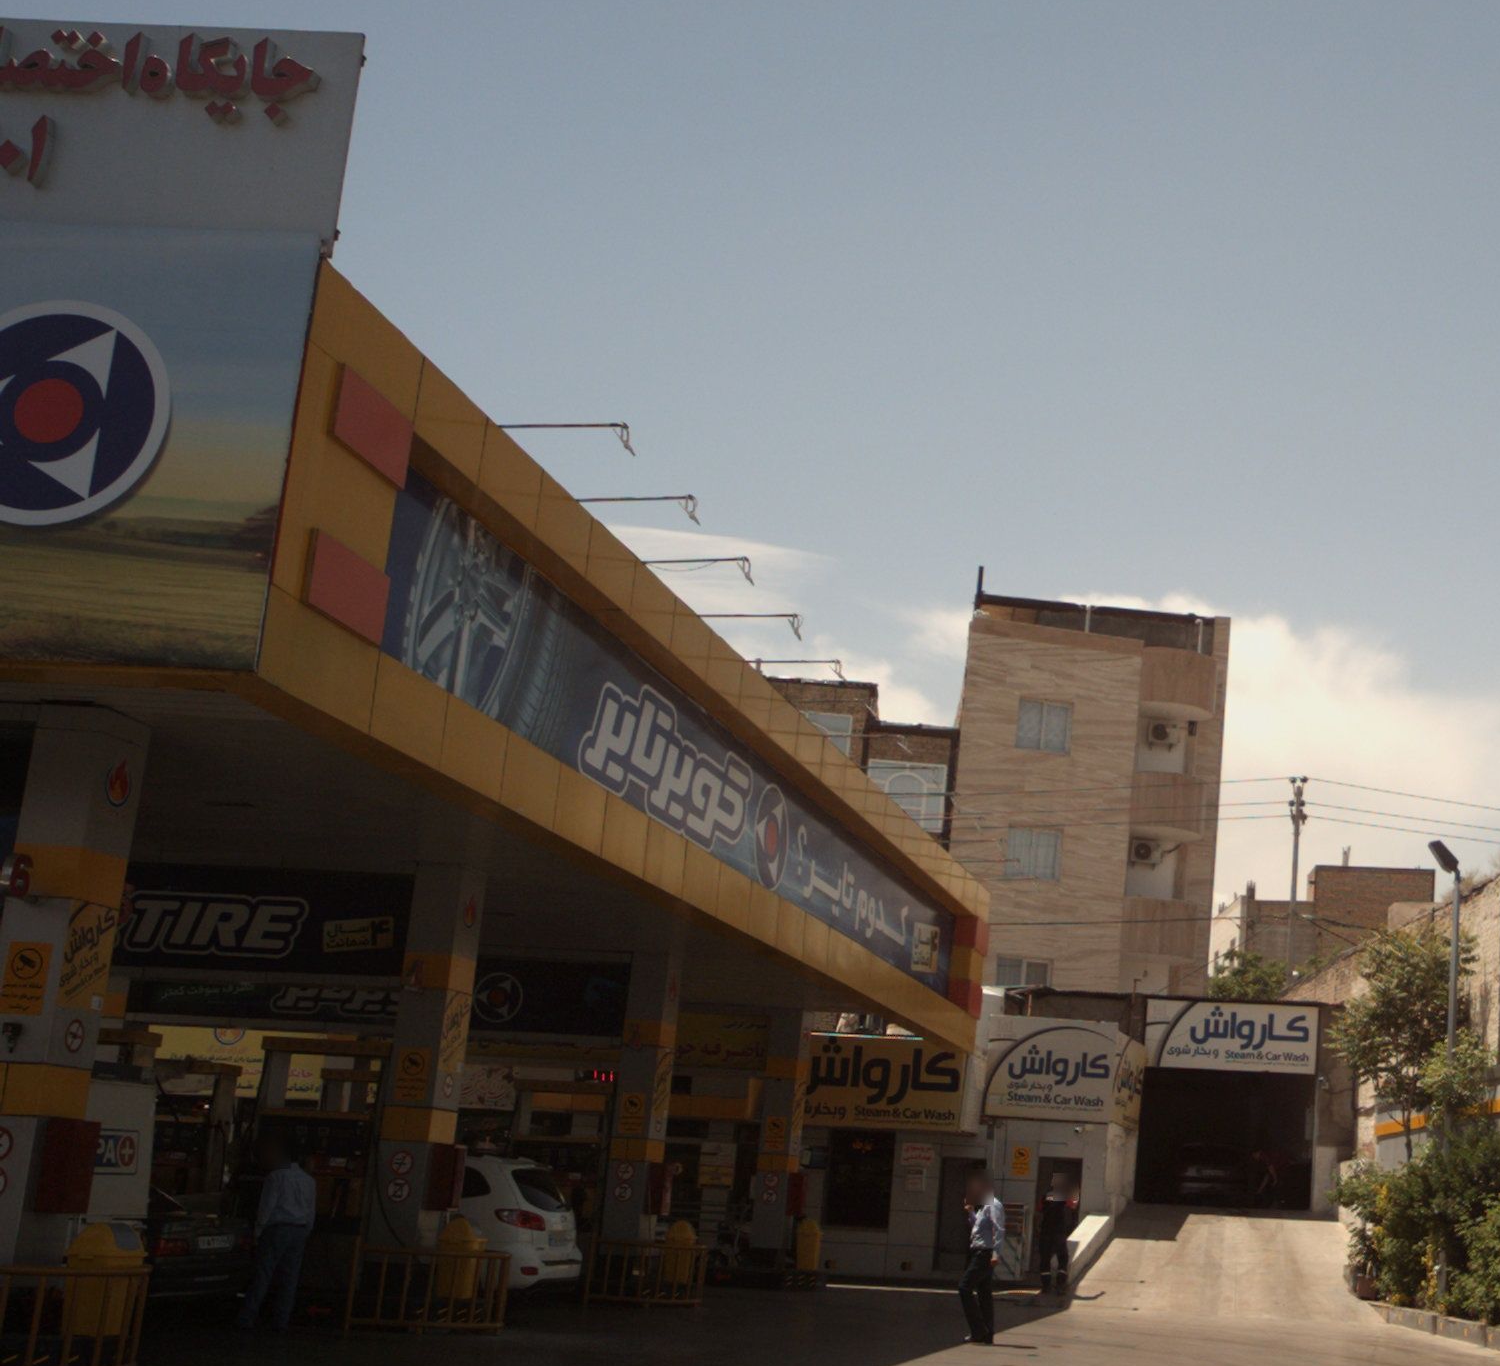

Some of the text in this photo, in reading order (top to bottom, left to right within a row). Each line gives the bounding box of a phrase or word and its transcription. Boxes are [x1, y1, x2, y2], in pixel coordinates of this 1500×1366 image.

[0, 24, 320, 125] جایگاه اختص
[8, 854, 33, 897] 6
[127, 892, 307, 957] TIRE
[1190, 1006, 1310, 1051] کارواش
[1008, 1044, 1110, 1086] کارواش
[1225, 1049, 1309, 1062] Steam & Car Wash
[855, 1105, 955, 1121] Steam & Car Wash
[1007, 1091, 1104, 1107] Steam & Car Wash
